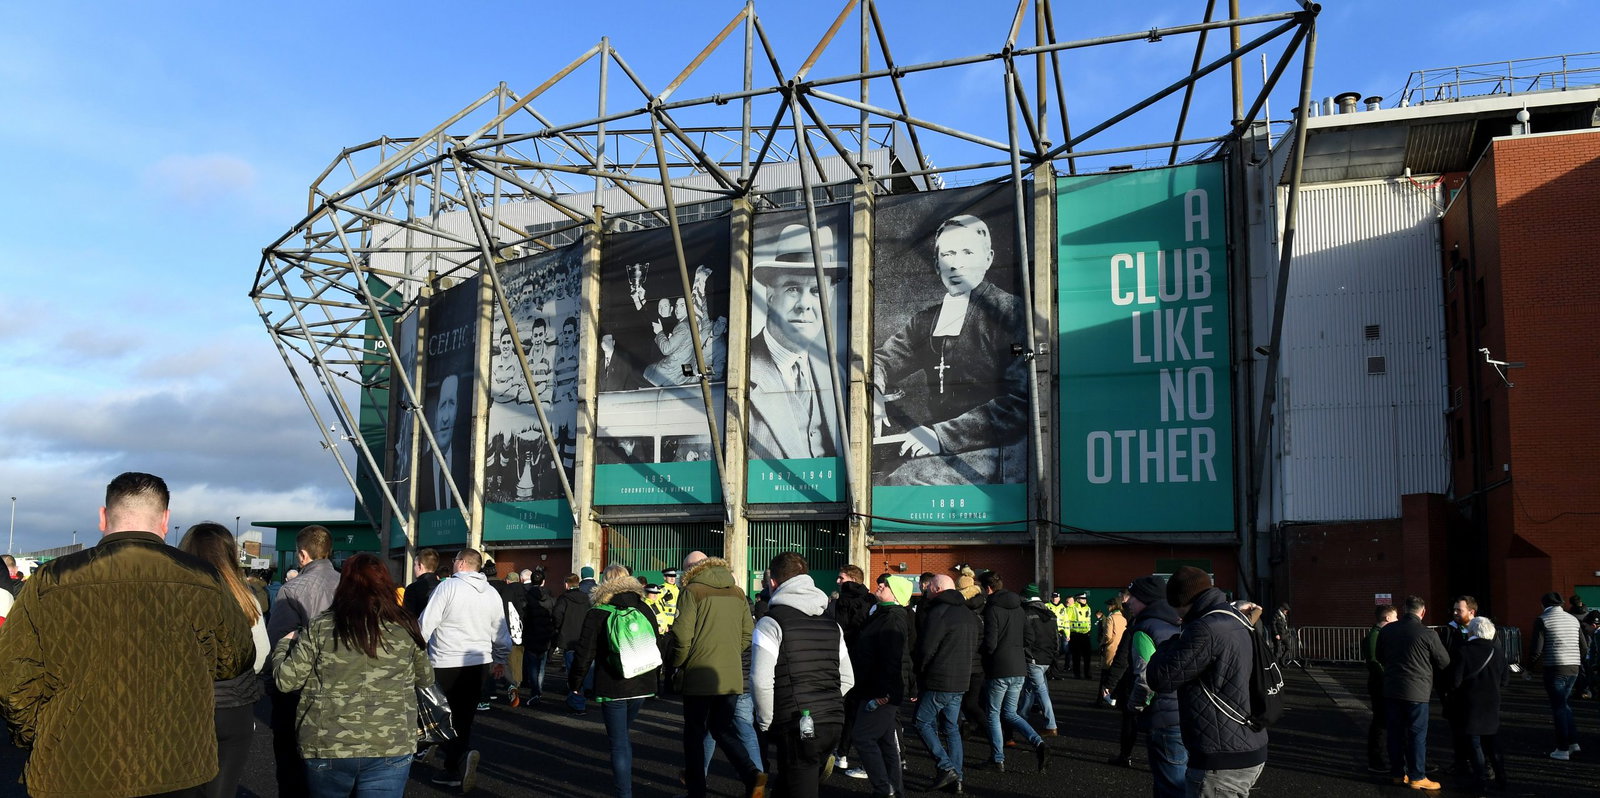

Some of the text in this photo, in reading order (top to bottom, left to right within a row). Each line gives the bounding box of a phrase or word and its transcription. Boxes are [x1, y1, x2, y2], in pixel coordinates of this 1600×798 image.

[1184, 188, 1209, 242] A
[1110, 246, 1211, 306] CLUB
[428, 324, 468, 356] CELTIC
[1132, 304, 1215, 363] LIKE
[1159, 366, 1215, 422] NO
[645, 474, 671, 483] 1953
[1086, 426, 1217, 484] OTHER
[931, 498, 965, 508] 1888
